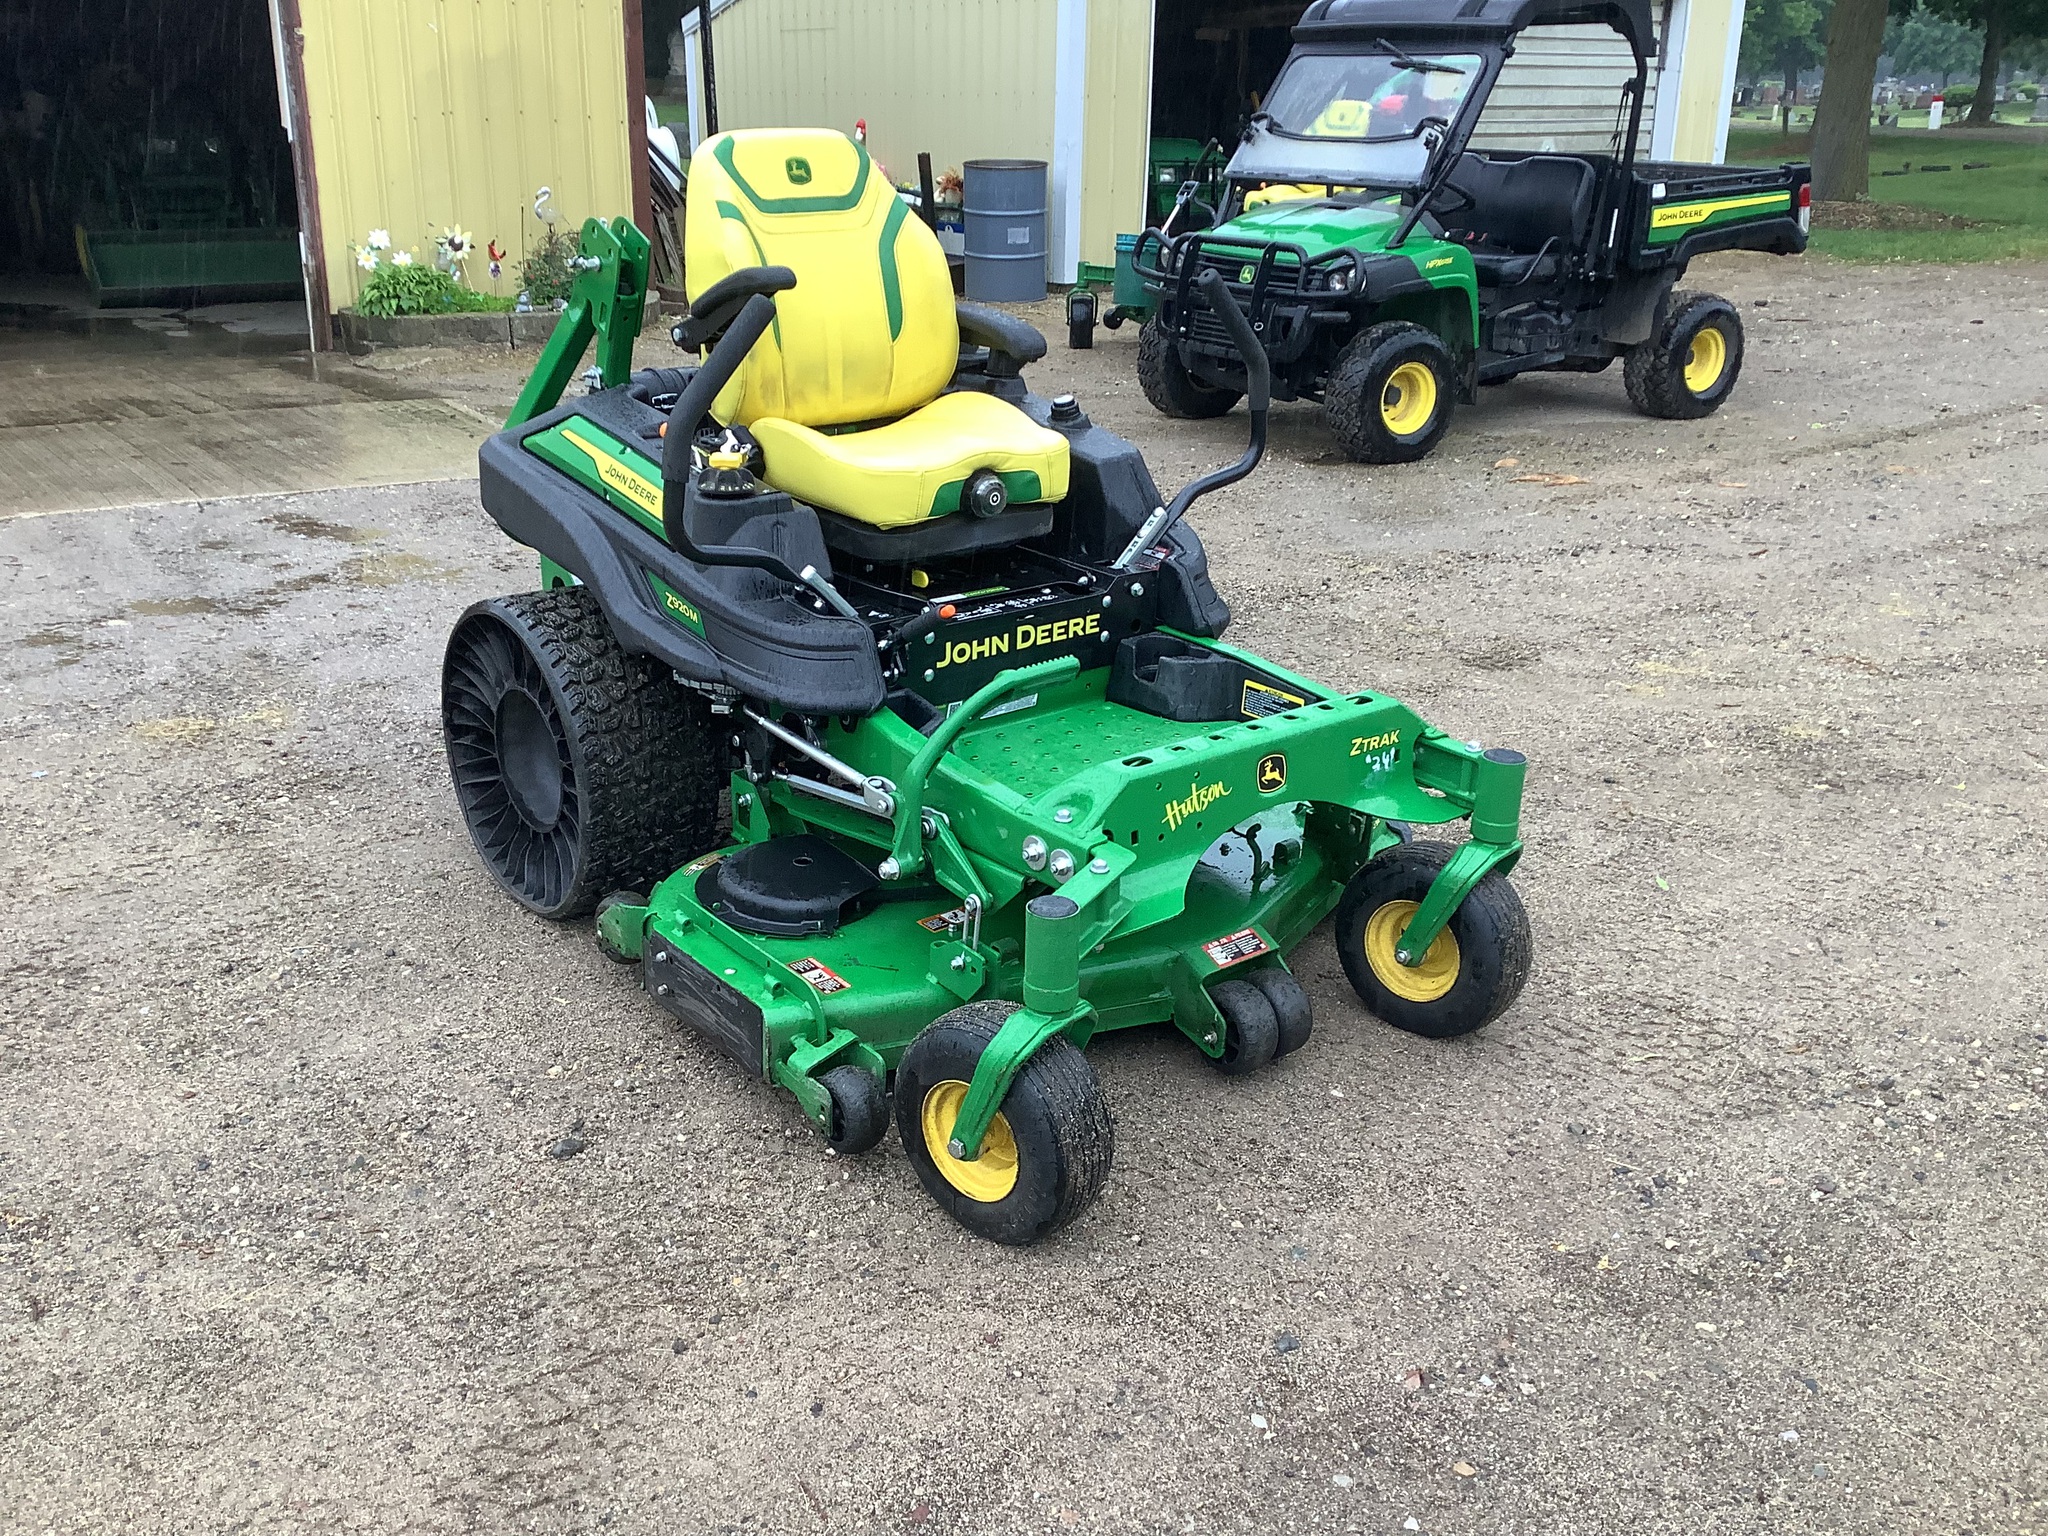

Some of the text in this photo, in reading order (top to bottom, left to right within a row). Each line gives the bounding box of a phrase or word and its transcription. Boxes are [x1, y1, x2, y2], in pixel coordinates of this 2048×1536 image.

[1658, 210, 1703, 222] JOHN DEERE
[605, 464, 658, 506] JOHN DEERE
[665, 591, 698, 624] Z920M
[936, 613, 1100, 668] JOHN DEERE
[1349, 729, 1400, 757] ZTRAK
[1161, 780, 1233, 832] Hutson
